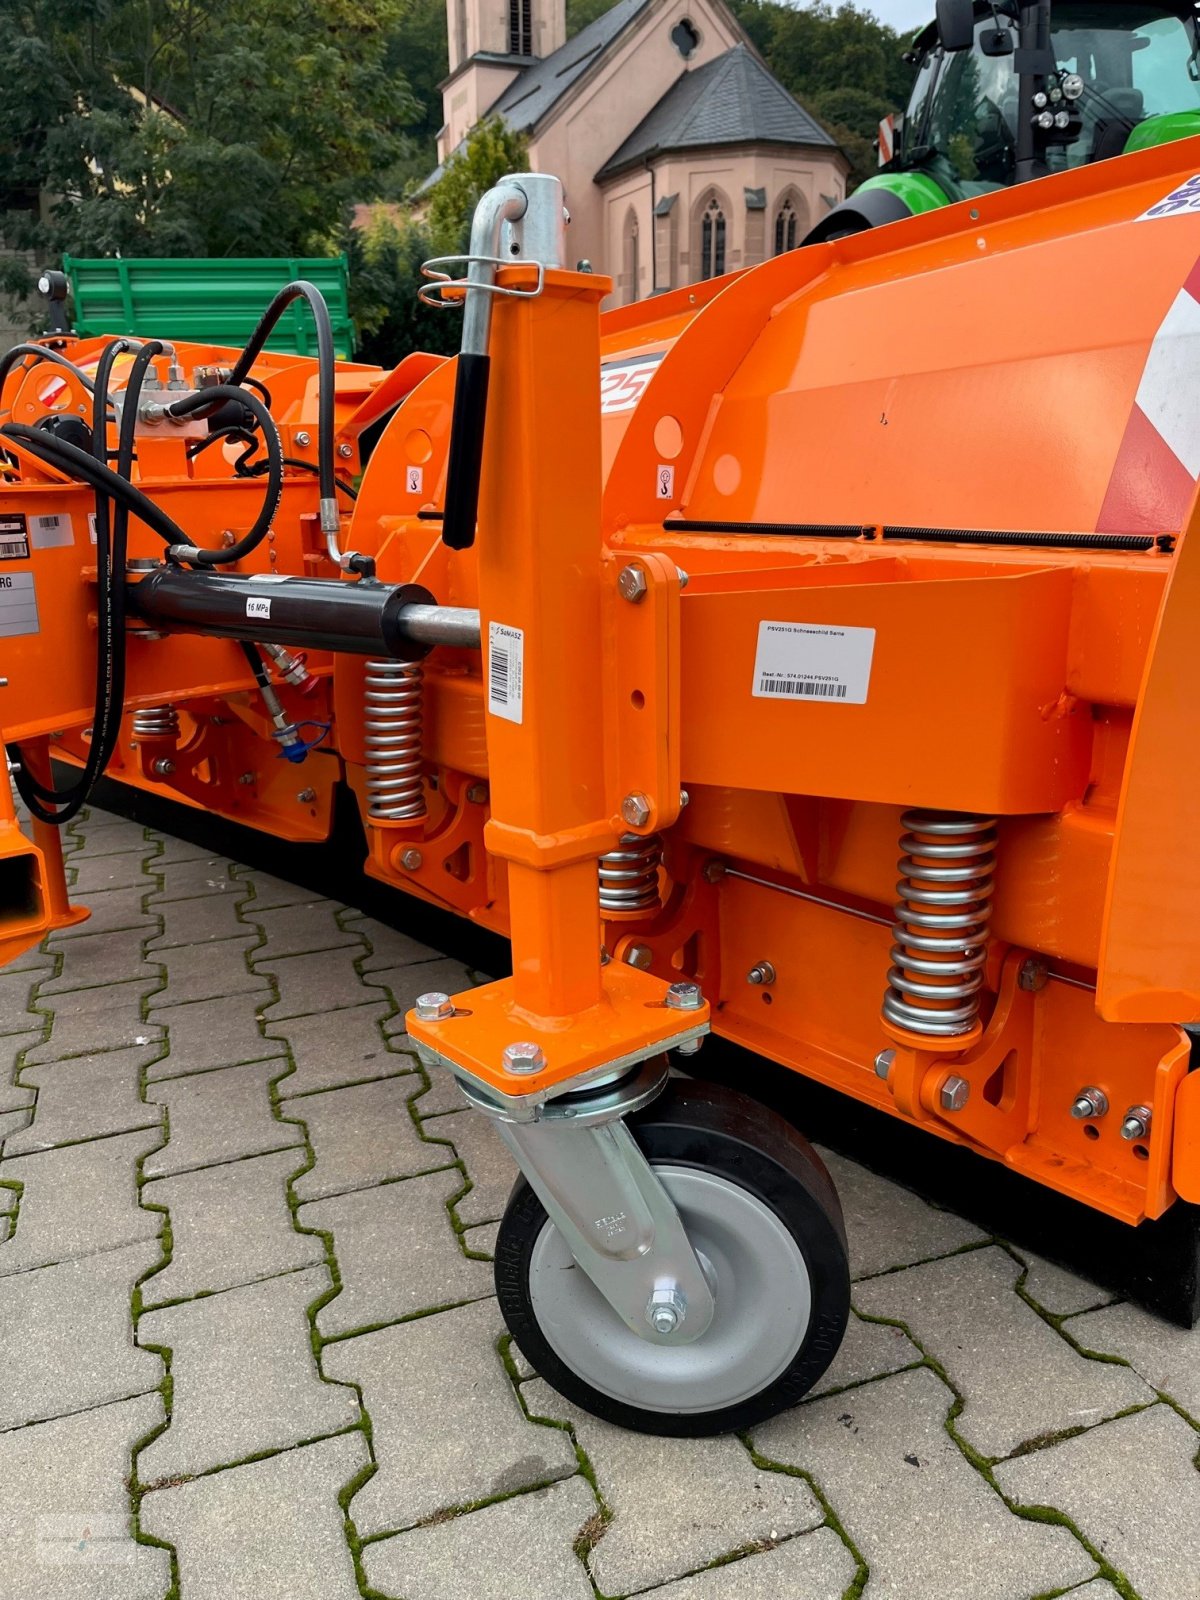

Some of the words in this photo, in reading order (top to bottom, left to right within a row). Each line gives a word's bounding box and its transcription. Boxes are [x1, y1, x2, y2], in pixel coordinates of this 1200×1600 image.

[247, 603, 255, 612] 16
[255, 603, 269, 613] MPa
[793, 627, 829, 635] Schneeschild
